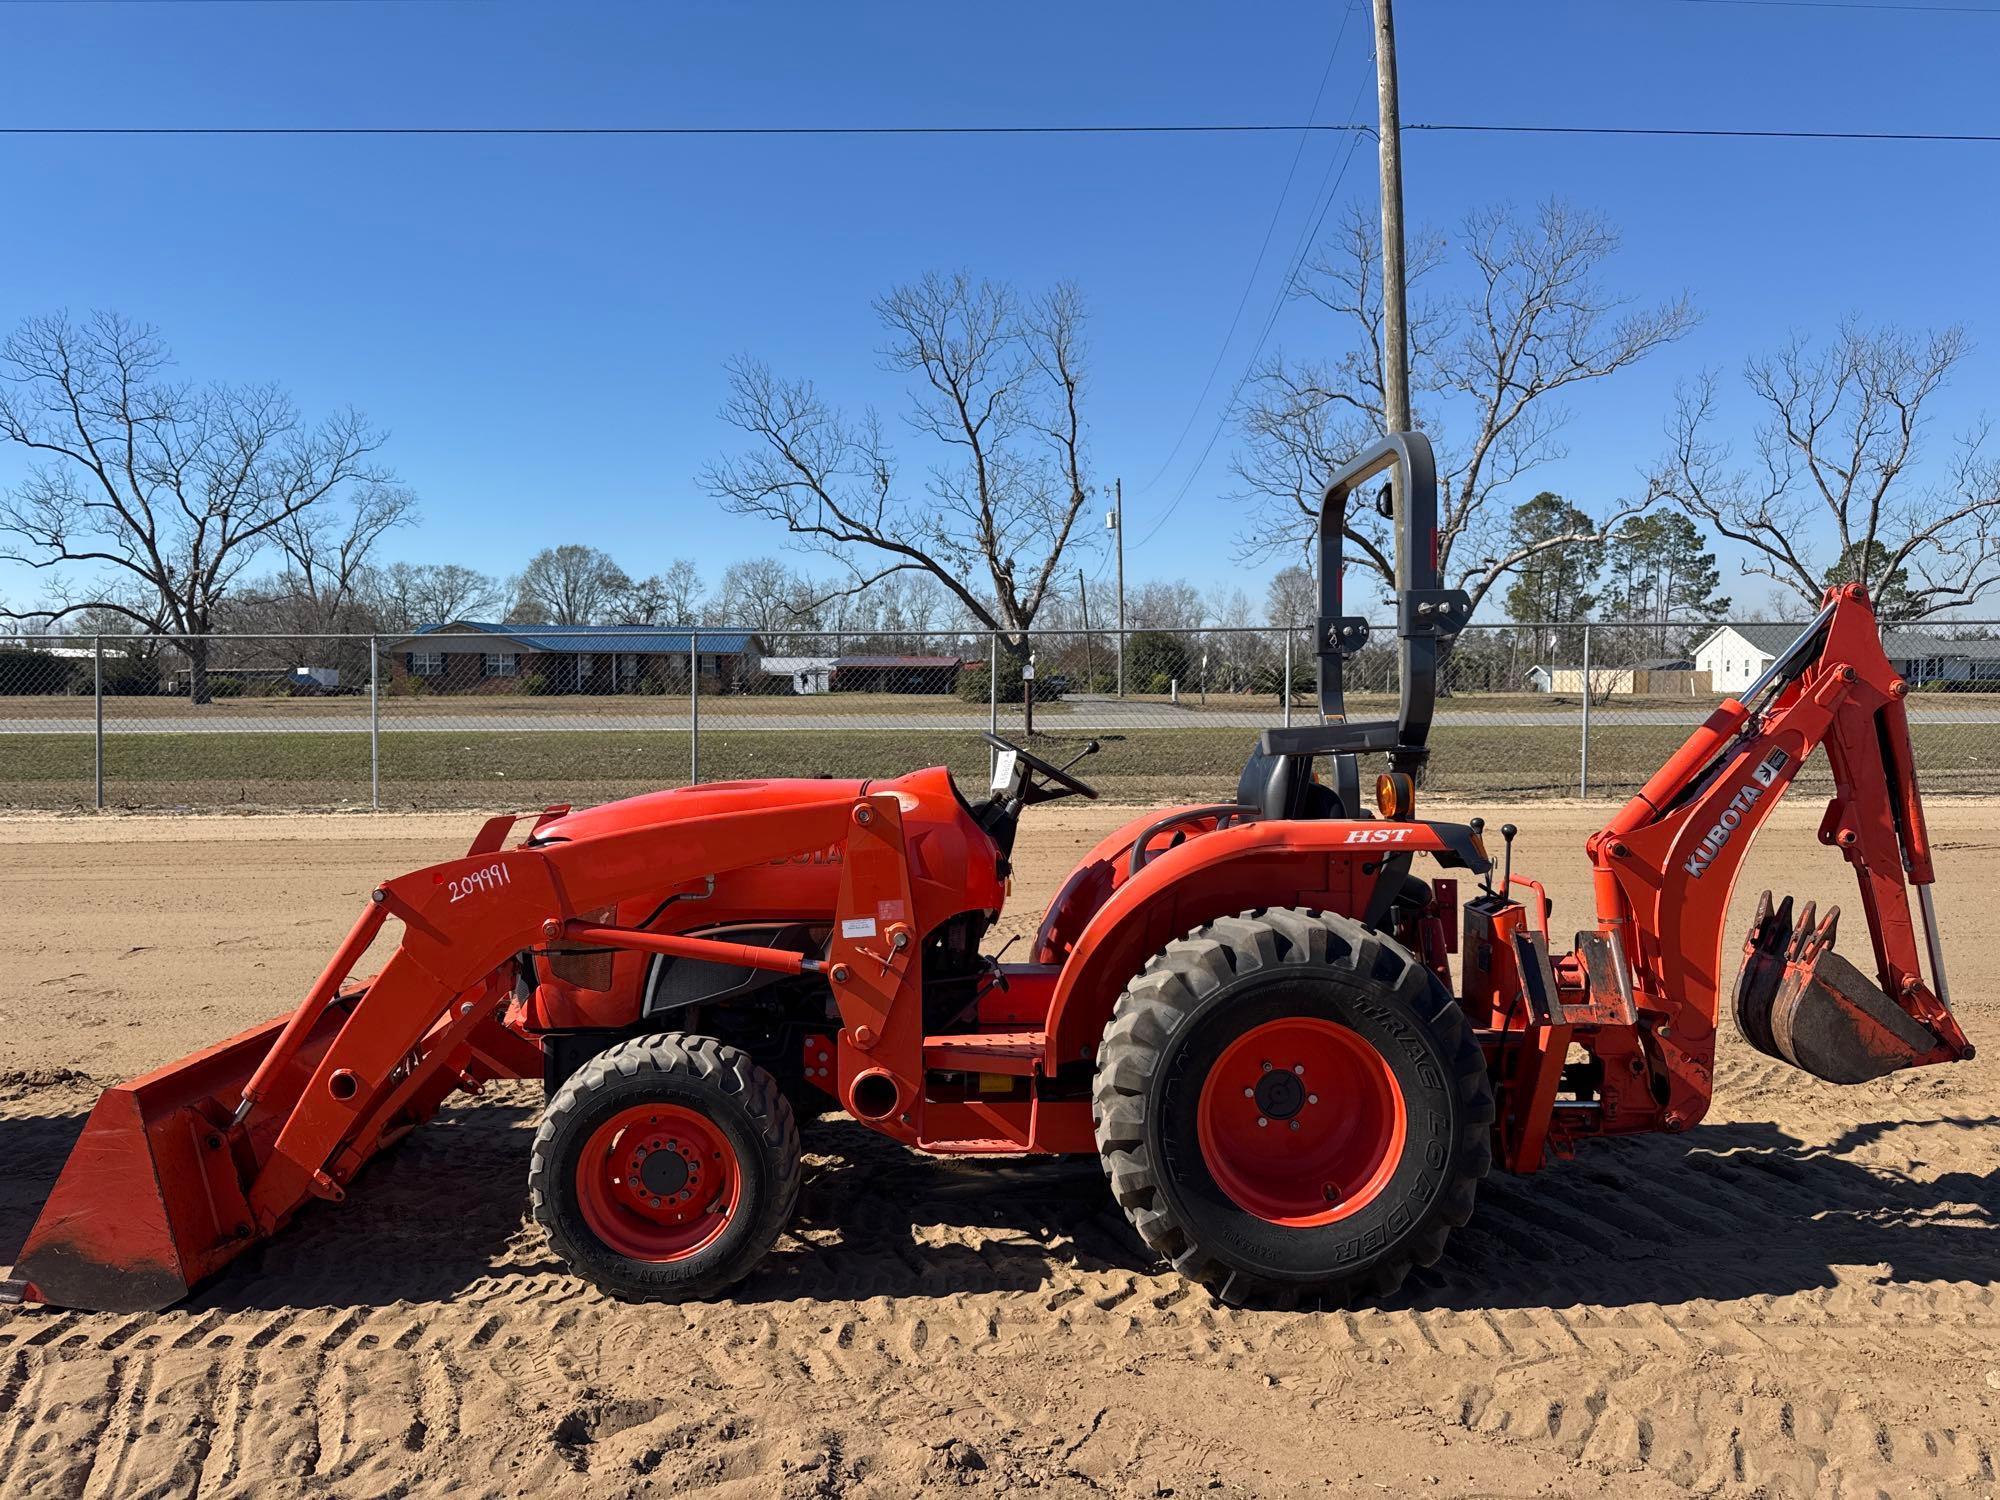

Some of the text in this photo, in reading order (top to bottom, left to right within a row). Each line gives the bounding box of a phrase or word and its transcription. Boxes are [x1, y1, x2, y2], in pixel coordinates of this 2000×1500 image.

[1344, 828, 1413, 844] HST
[1683, 784, 1765, 880] KUBOTA
[447, 861, 512, 904] 209991
[1334, 1108, 1449, 1264] LOADER
